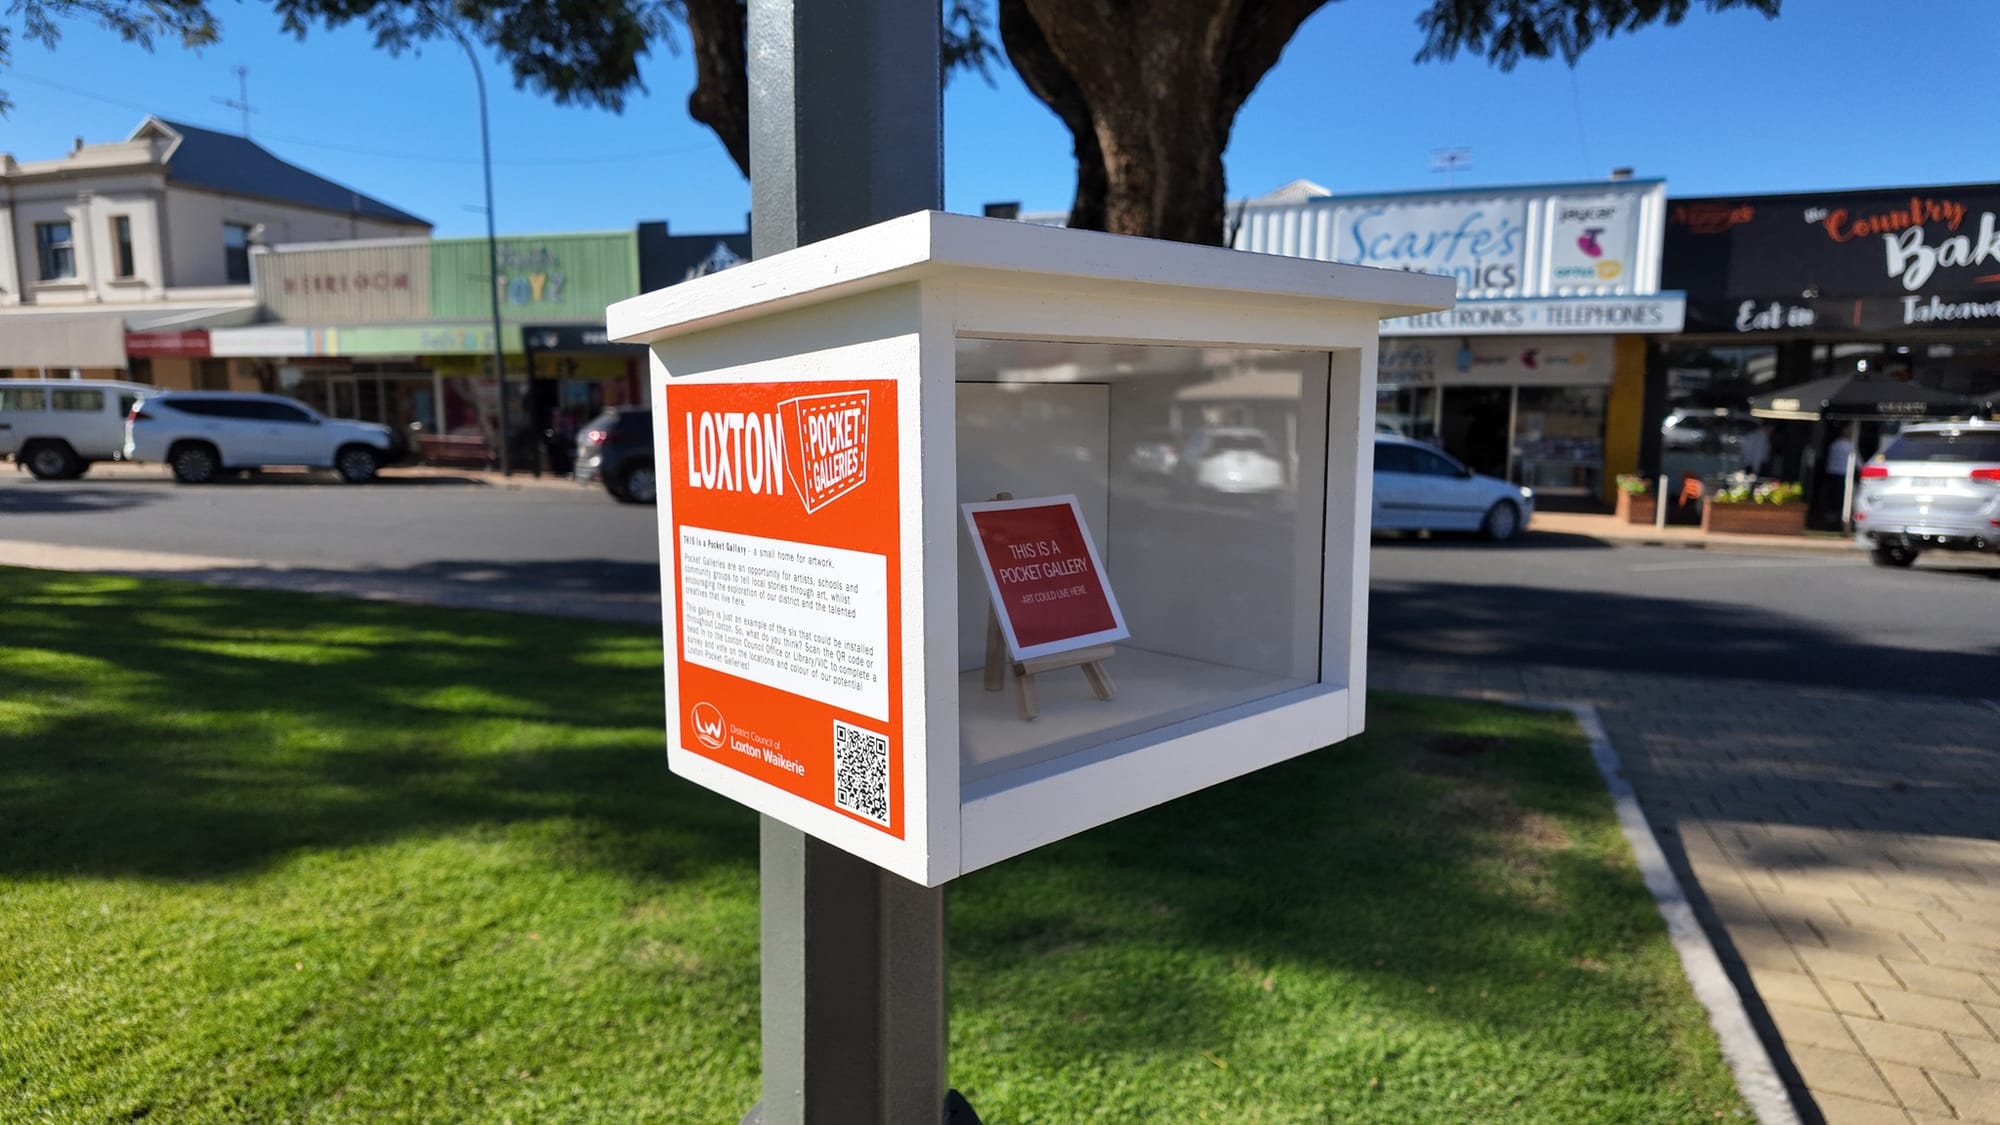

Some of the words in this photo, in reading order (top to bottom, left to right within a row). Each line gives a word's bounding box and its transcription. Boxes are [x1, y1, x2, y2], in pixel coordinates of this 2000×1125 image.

[1342, 209, 1522, 265] Scarfe's
[1822, 196, 1967, 243] Country
[1408, 303, 1523, 328] ELECTRONICS
[1546, 304, 1664, 324] TELEPHONES
[1735, 300, 1782, 333] Eat
[686, 411, 783, 496] LOXTON
[808, 407, 861, 459] POCKET
[813, 446, 858, 493] GALLERIES
[683, 534, 695, 545] THIS
[695, 536, 701, 546] is
[707, 538, 724, 550] Pocket
[725, 541, 746, 556] Gallery
[759, 548, 775, 559] small
[777, 549, 793, 562] home
[796, 552, 806, 564] for
[807, 555, 834, 568] artwork.
[1000, 564, 1042, 584] POCKET
[1043, 557, 1088, 577] GALLERY
[1008, 543, 1036, 560] THIS
[1036, 541, 1050, 557] IS
[1052, 540, 1061, 555] A
[683, 552, 701, 564] Pocket
[702, 555, 725, 569] Galleries
[727, 562, 736, 571] are
[738, 564, 745, 573] an
[747, 565, 780, 581] opportunity
[781, 570, 791, 581] for
[793, 573, 815, 587] artists,
[817, 577, 842, 591] schools
[844, 582, 858, 594] and
[684, 565, 711, 579] community
[712, 570, 731, 582] groups
[732, 573, 739, 583] to
[740, 574, 750, 585] tell
[751, 576, 766, 588] local
[767, 580, 787, 592] stories
[789, 584, 814, 599] through
[816, 590, 828, 601] art,
[830, 592, 850, 605] whilst
[684, 575, 715, 591] encouraging
[716, 580, 726, 591] the
[727, 584, 757, 598] exploration
[758, 589, 765, 599] of
[766, 592, 777, 602] our
[777, 593, 800, 607] district
[801, 599, 813, 610] and
[815, 600, 825, 612] the
[828, 603, 856, 619] talented
[685, 586, 707, 598] creatives
[708, 590, 719, 601] that
[720, 592, 730, 603] live
[731, 594, 744, 606] here.
[1022, 594, 1034, 604] ART
[1034, 590, 1057, 603] COULD
[1056, 588, 1070, 599] LIVE
[686, 601, 696, 613] This
[697, 605, 714, 619] gallery
[715, 608, 721, 619] is
[722, 612, 733, 622] just
[734, 614, 742, 624] an
[743, 617, 767, 630] example
[768, 622, 775, 632] of
[776, 623, 787, 635] the
[788, 626, 796, 637] six
[798, 628, 812, 641] that
[813, 634, 831, 646] could
[832, 636, 842, 648] be
[843, 639, 874, 656] installed
[686, 613, 713, 628] throughout
[714, 620, 733, 633] Loxton.
[734, 625, 744, 637] So,
[745, 628, 760, 640] what
[761, 631, 769, 642] do
[770, 635, 781, 646] you
[783, 636, 802, 651] think?
[804, 642, 820, 655] Scan
[822, 646, 834, 659] the
[835, 649, 846, 663] QR
[847, 654, 864, 667] code
[865, 659, 873, 669] or
[686, 623, 699, 635] head
[700, 627, 705, 637] in
[706, 628, 713, 638] to
[714, 630, 723, 641] the
[724, 633, 742, 646] Loxton
[743, 638, 764, 652] Council
[765, 643, 783, 657] Office
[784, 650, 790, 659] or
[793, 651, 828, 669] Library/VIC
[830, 660, 837, 672] to
[838, 664, 870, 680] complete
[686, 636, 703, 648] survey
[704, 640, 714, 650] and
[715, 643, 727, 654] vote
[729, 647, 736, 656] on
[737, 648, 747, 659] the
[748, 651, 774, 667] locations
[776, 660, 788, 670] and
[789, 663, 809, 676] colour
[810, 668, 818, 679] of
[820, 672, 832, 683] our
[833, 675, 863, 691] potential
[687, 644, 704, 657] Loxton
[704, 649, 722, 663] Pocket
[723, 654, 750, 670] Galleries!
[730, 723, 750, 740] District
[750, 731, 774, 747] Council
[773, 741, 781, 750] of
[730, 735, 761, 760] Loxton
[762, 747, 806, 777] Waikerie
